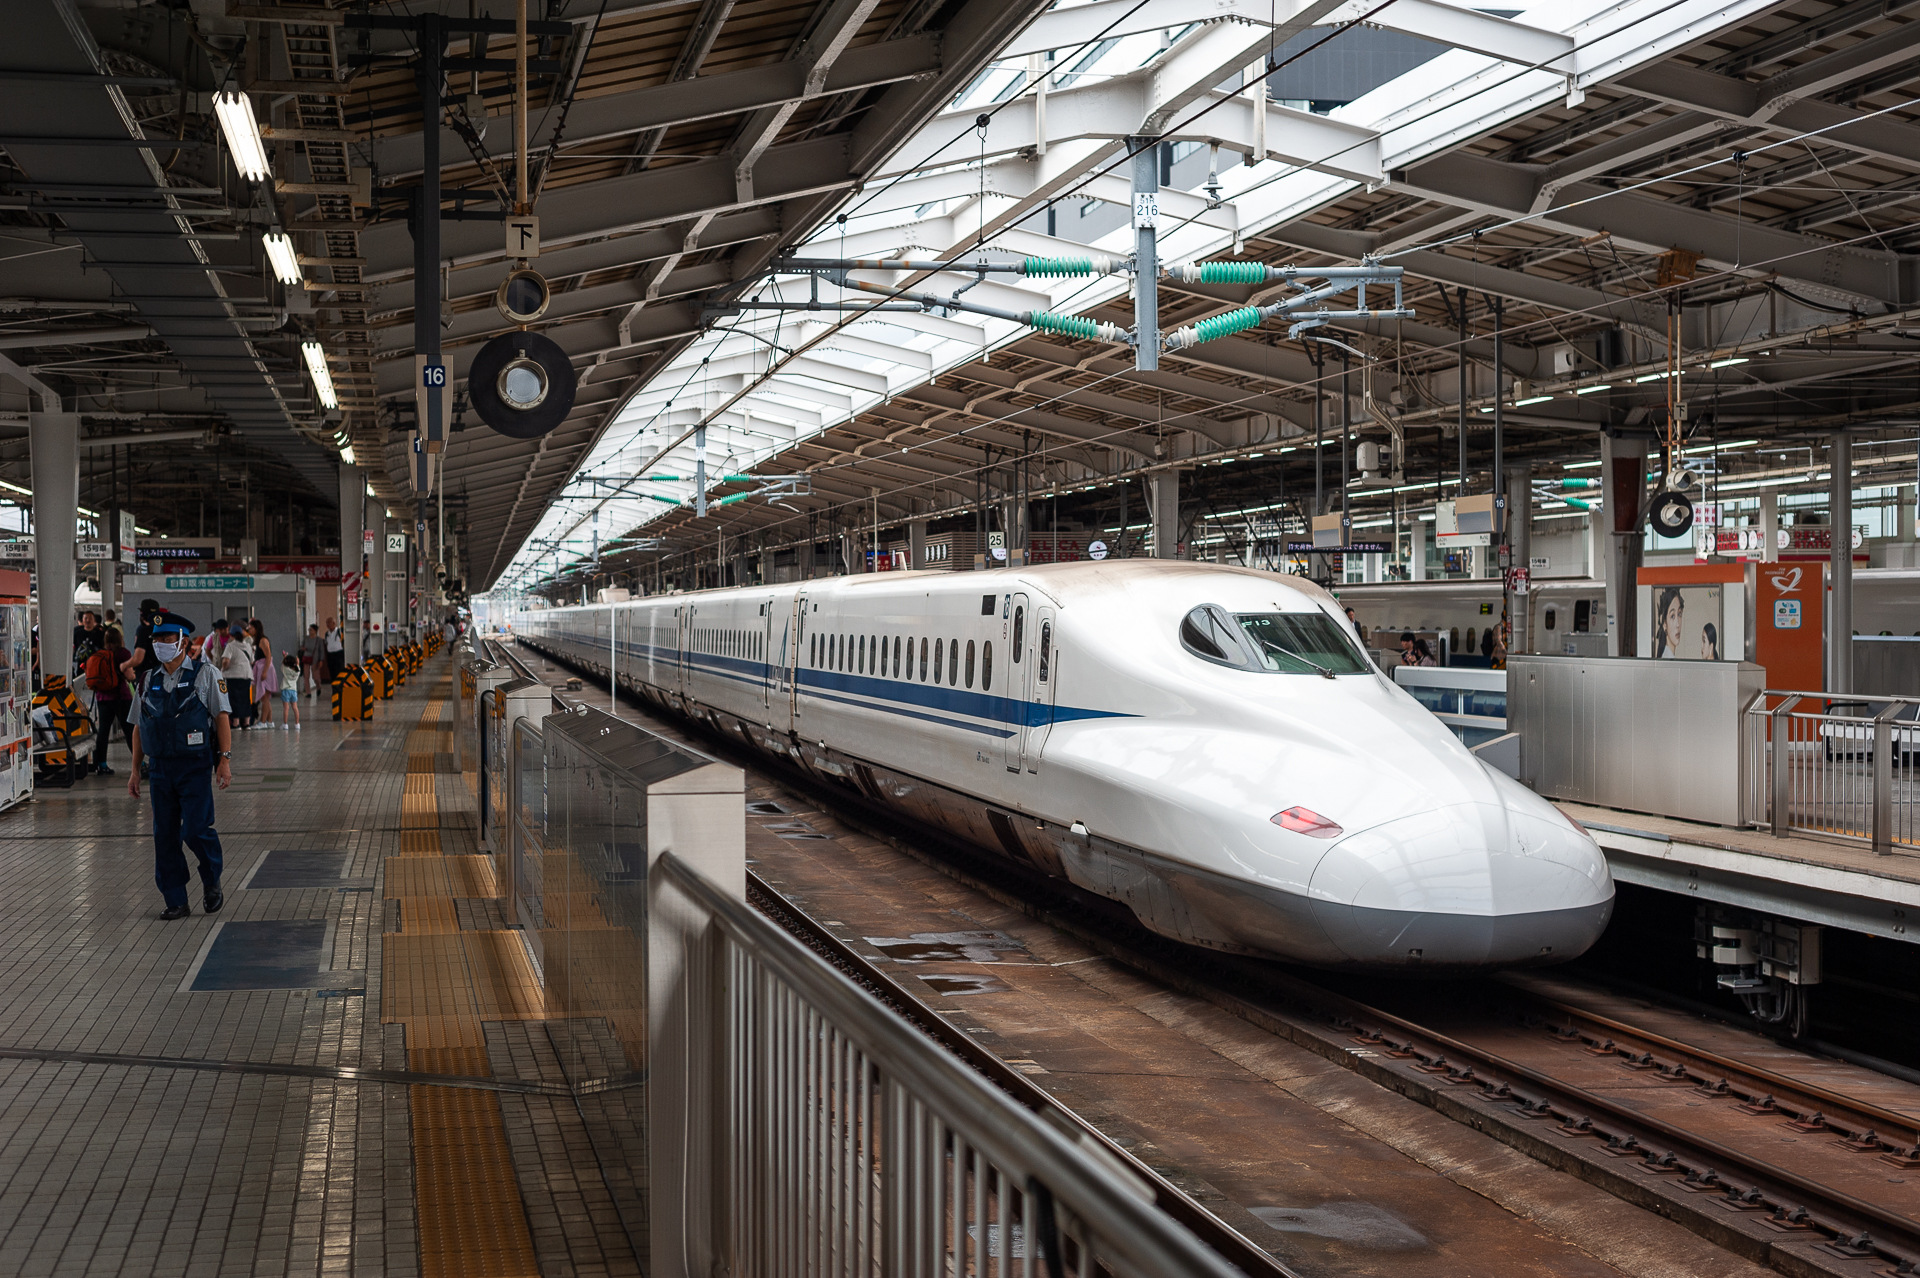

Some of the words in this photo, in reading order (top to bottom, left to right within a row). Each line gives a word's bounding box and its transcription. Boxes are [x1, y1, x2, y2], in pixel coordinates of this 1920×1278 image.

[1137, 204, 1158, 216] 216
[511, 223, 534, 250] 下
[425, 368, 443, 385] 16
[1676, 405, 1685, 418] 下
[415, 439, 421, 452] 1
[1495, 499, 1504, 507] 16
[417, 523, 425, 531] 15
[1342, 518, 1350, 526] 15
[990, 535, 1002, 546] 25
[1794, 530, 1831, 540] DELIC
[389, 537, 402, 549] 24
[1794, 540, 1831, 549] STATIO
